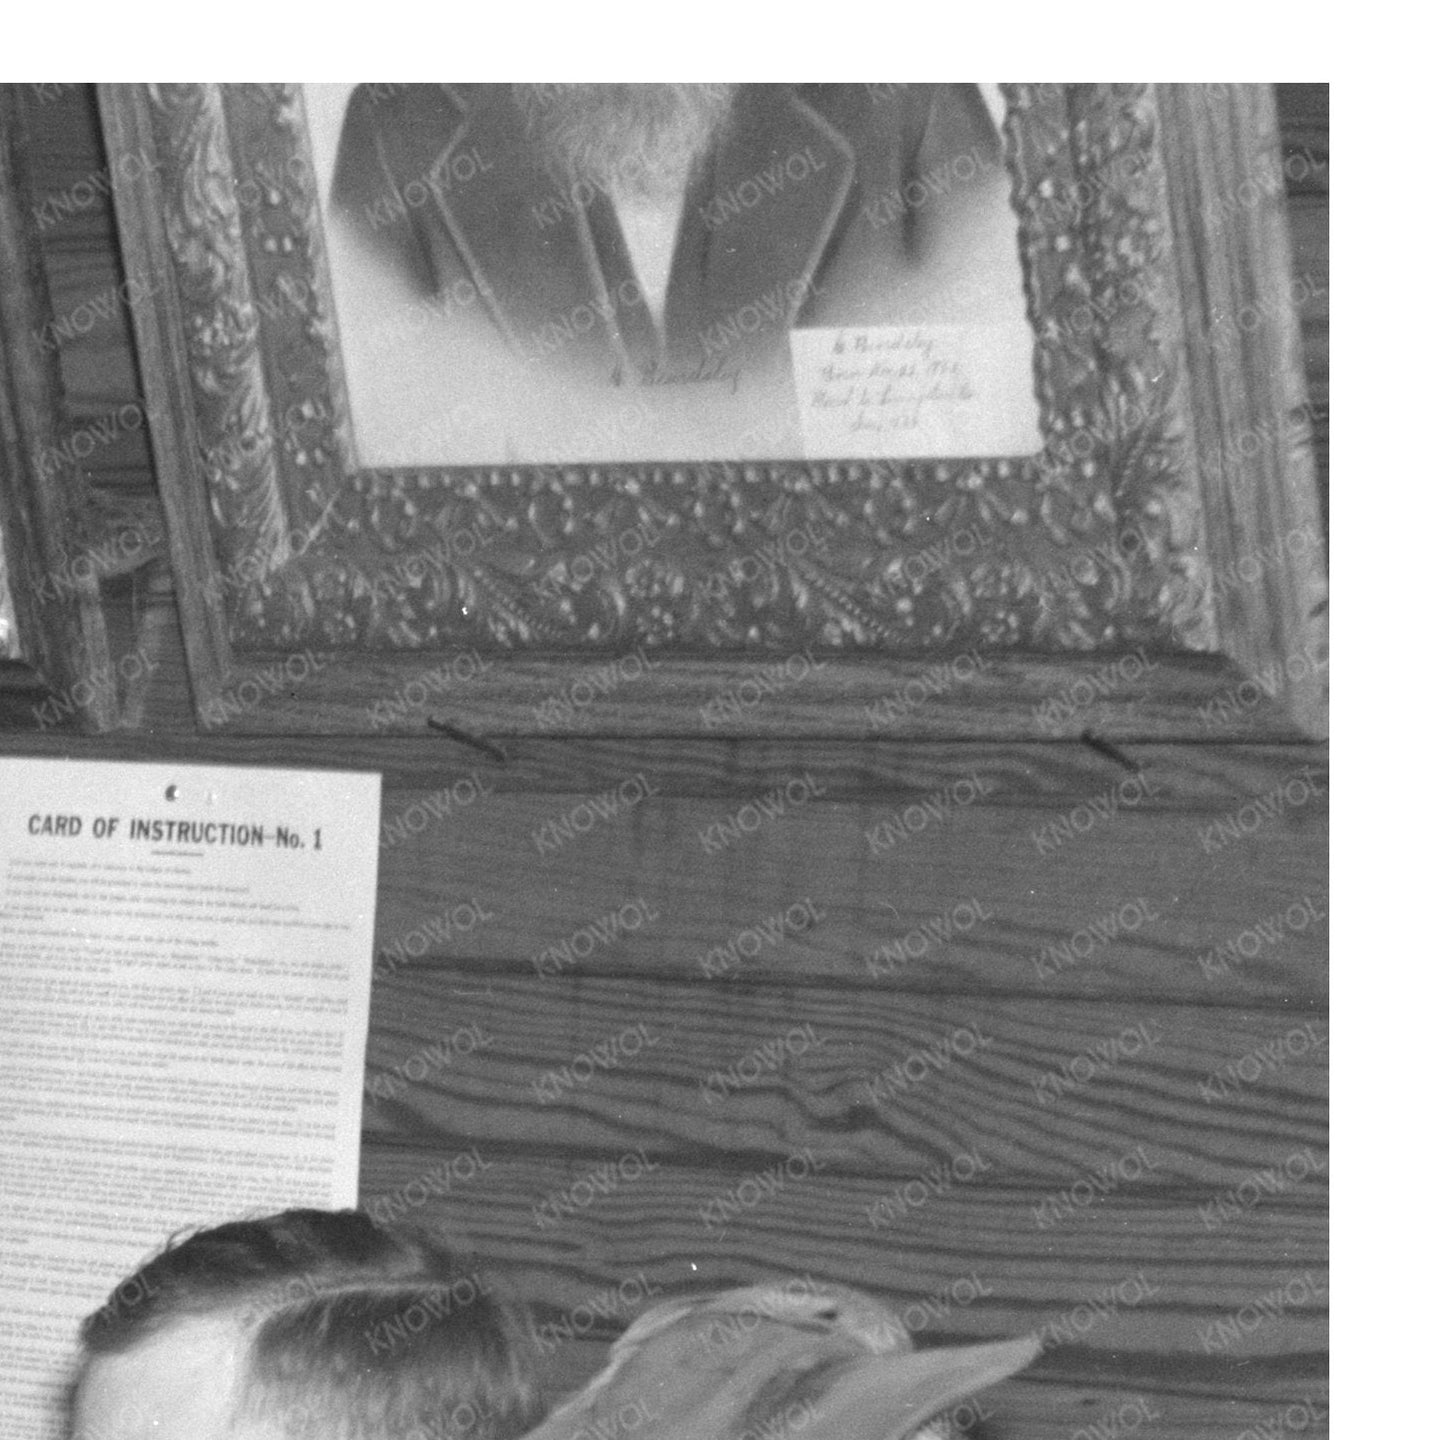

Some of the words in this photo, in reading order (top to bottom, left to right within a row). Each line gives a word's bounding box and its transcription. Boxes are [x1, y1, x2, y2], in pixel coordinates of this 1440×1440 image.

[27, 813, 83, 838] CARD
[92, 816, 120, 839] OF
[312, 828, 323, 851] 1
